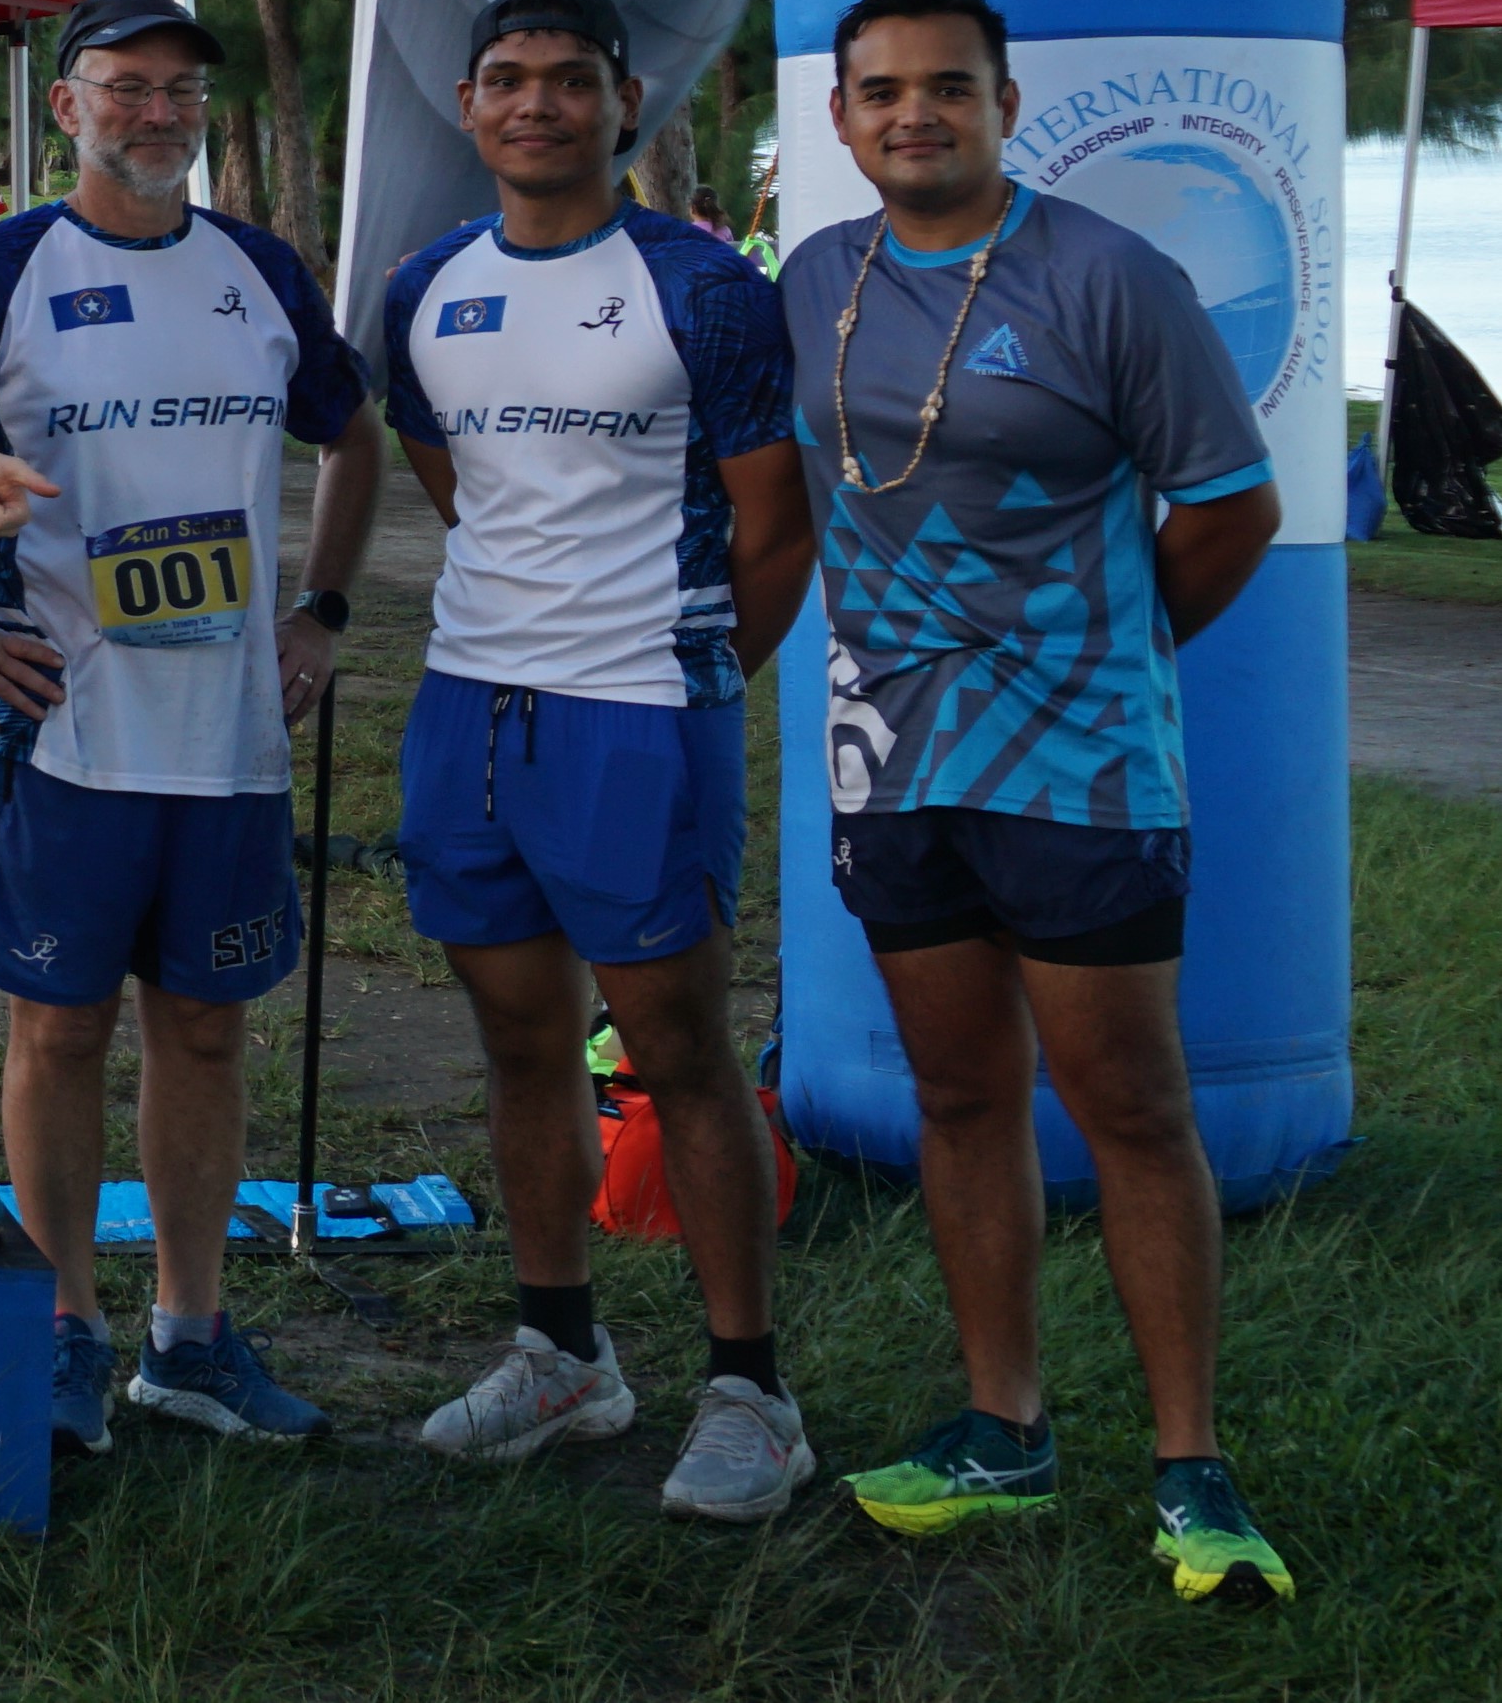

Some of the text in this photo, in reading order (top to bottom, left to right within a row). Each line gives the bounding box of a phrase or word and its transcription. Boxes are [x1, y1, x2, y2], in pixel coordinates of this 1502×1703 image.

[1001, 68, 1311, 179] NTERNATIONAL
[1039, 117, 1155, 187] LEADERSHIP
[1182, 114, 1267, 156] INTEGRITY
[1274, 167, 1311, 313] PERSEVERANCE
[1303, 197, 1332, 388] SCHOOL
[1259, 333, 1306, 418] INITIATIVE
[48, 395, 286, 437] RUN SAIPAN
[496, 406, 657, 437] SAIPAN
[115, 547, 239, 617] 001
